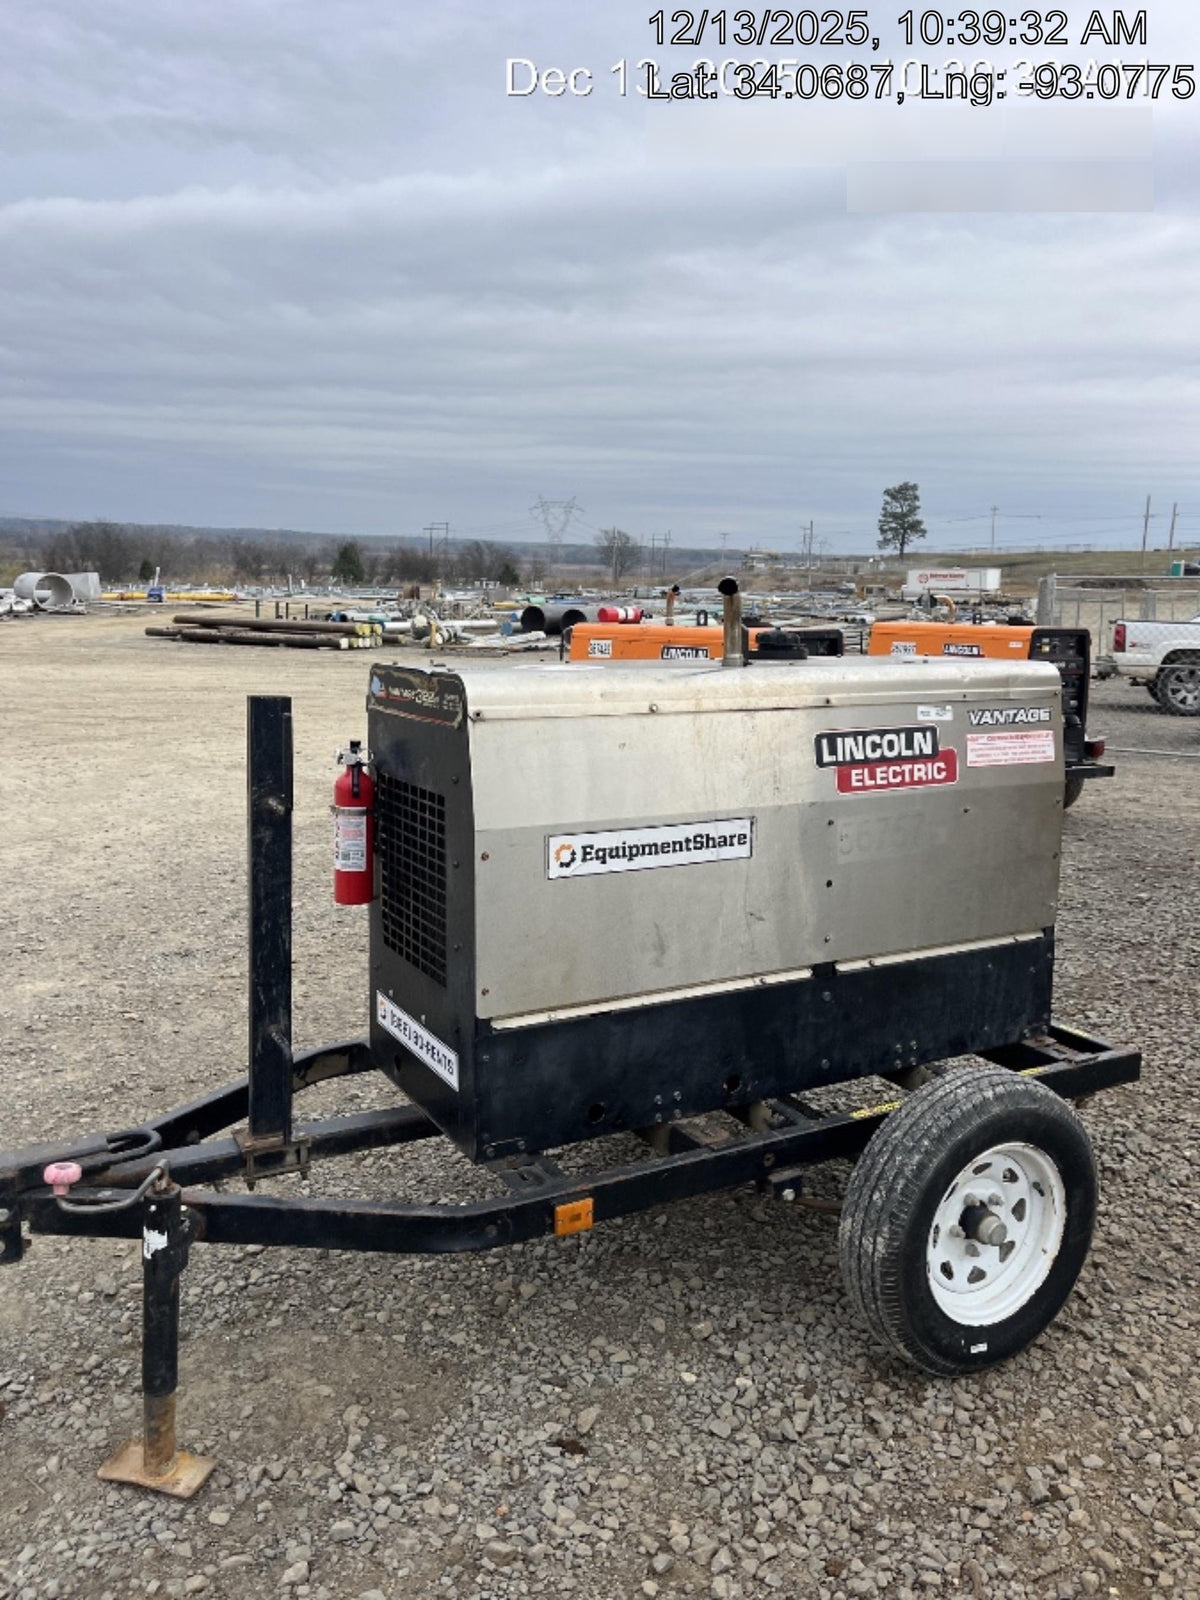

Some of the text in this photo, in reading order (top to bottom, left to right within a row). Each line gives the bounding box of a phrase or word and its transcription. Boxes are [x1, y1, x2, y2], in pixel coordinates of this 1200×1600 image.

[662, 647, 709, 660] LINCOLN
[943, 643, 980, 656] LINCOLN
[968, 707, 1052, 726] VANTAGE
[821, 730, 933, 764] LINCOLN
[850, 761, 947, 787] ELECTRIC
[580, 832, 748, 864] EquipmentShare
